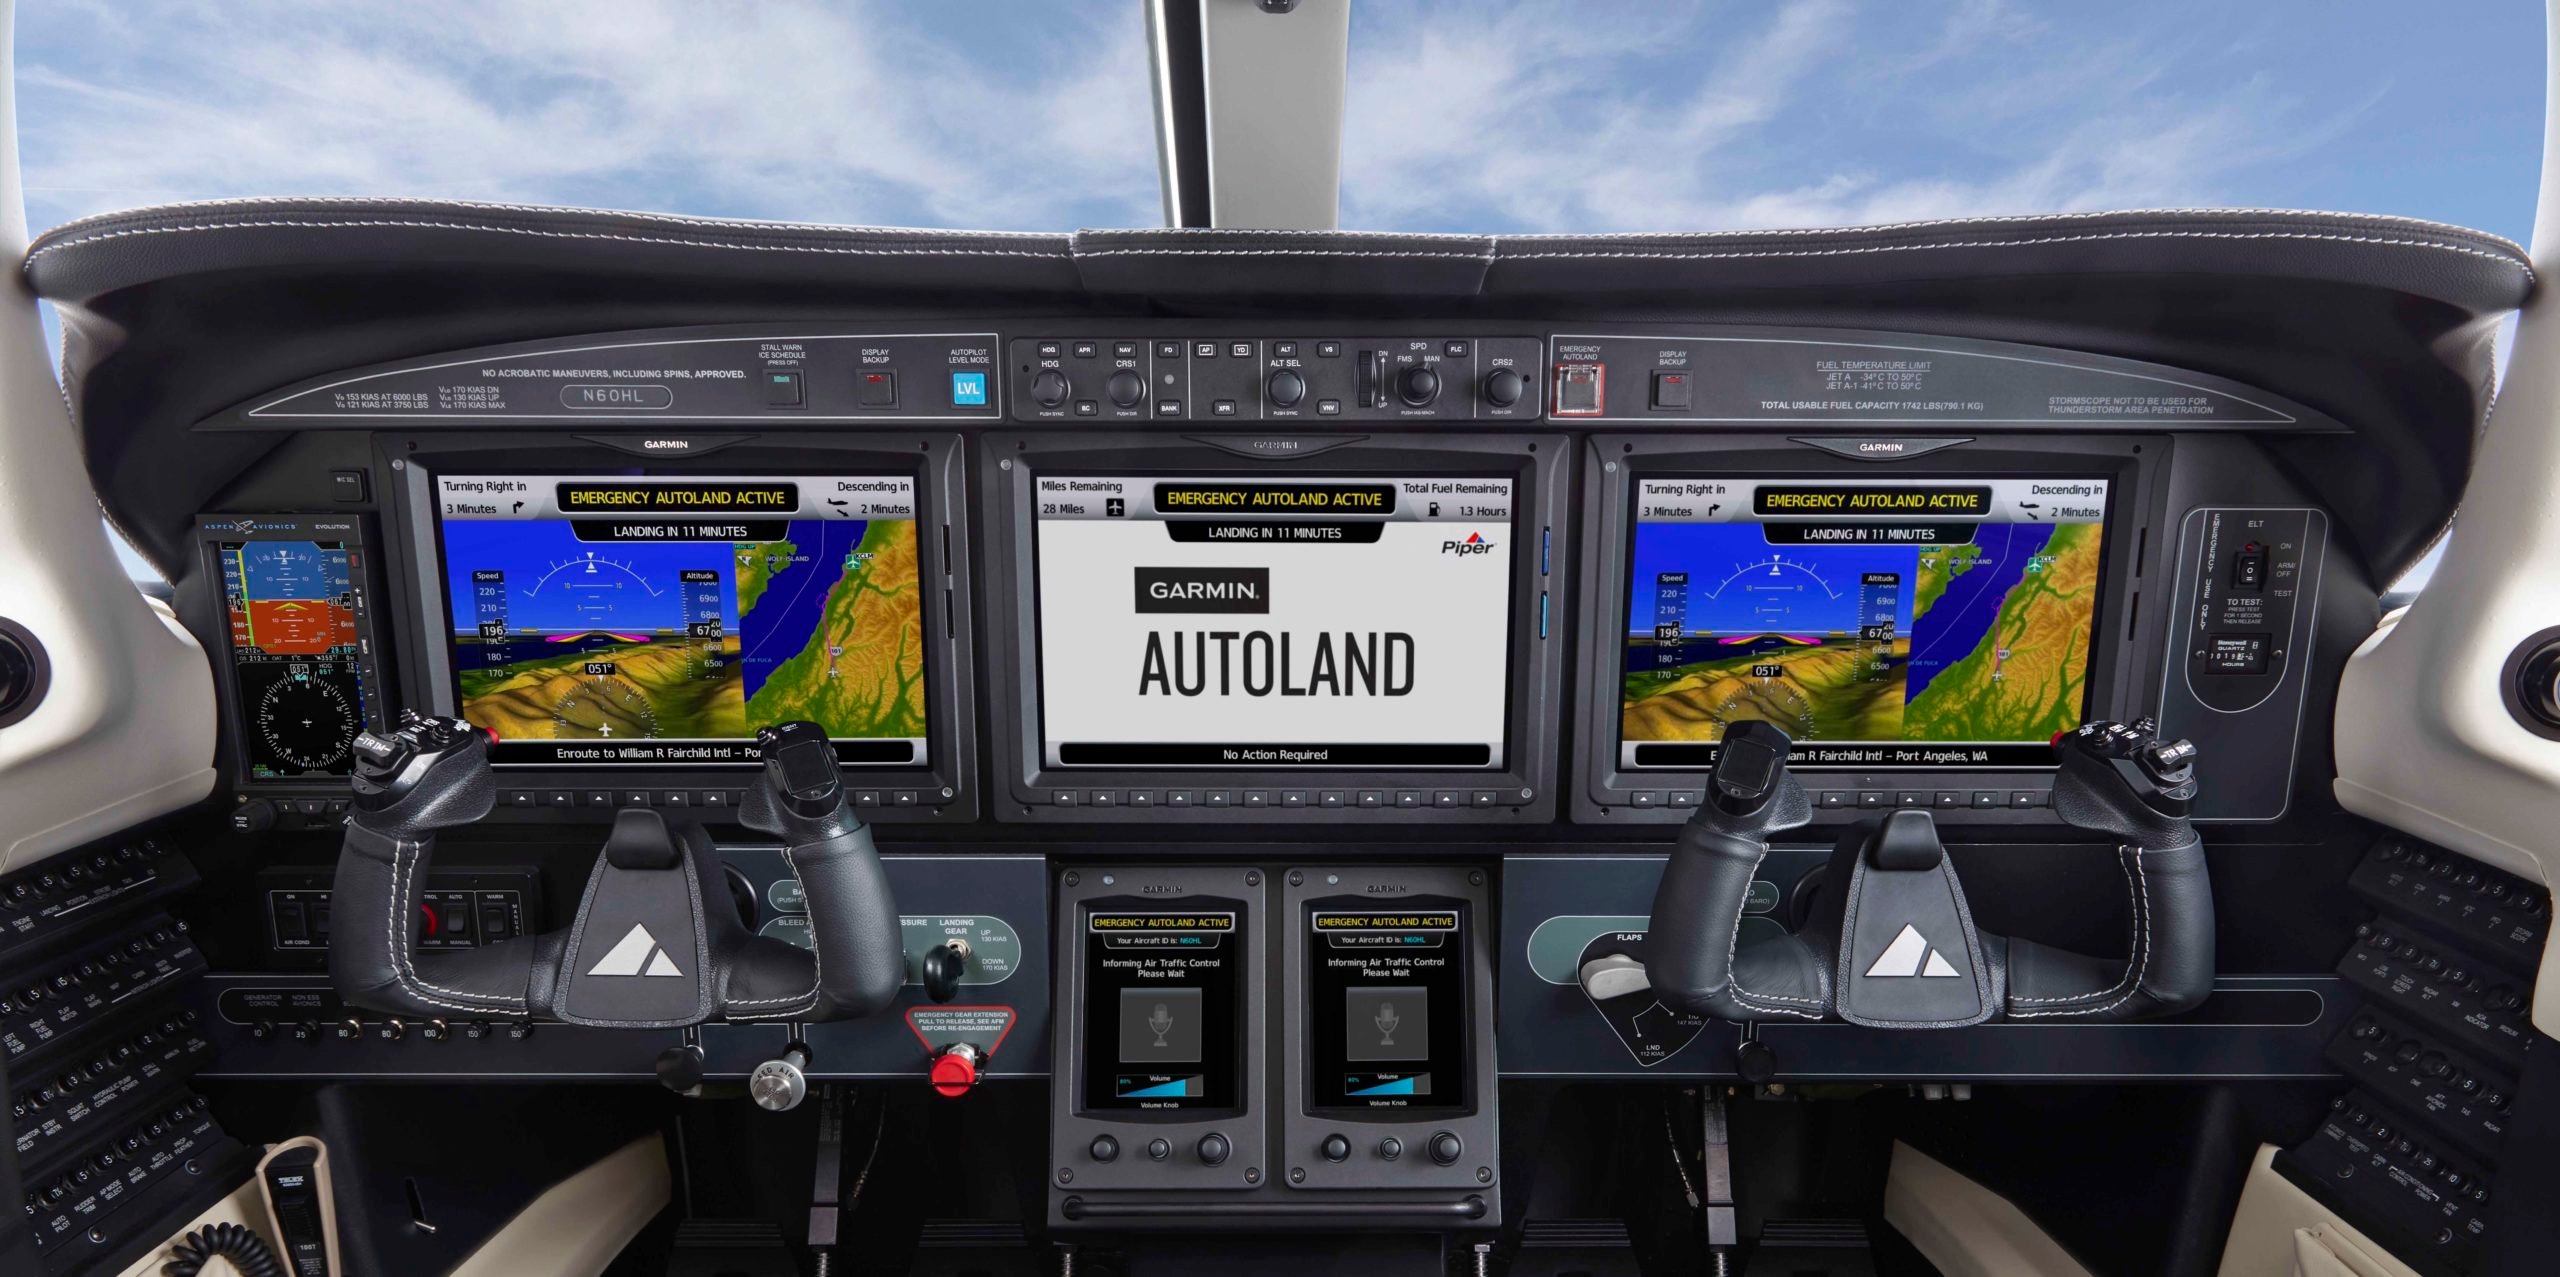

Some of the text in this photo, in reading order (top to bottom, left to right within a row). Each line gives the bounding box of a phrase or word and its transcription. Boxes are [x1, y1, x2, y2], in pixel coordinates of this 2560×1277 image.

[1817, 361, 1931, 370] FUEL TEMPERATURE LIMIT
[498, 369, 550, 377] ACROBATIC
[552, 369, 611, 378] MANEUVERS,
[613, 370, 662, 378] INCLUDING
[664, 370, 693, 379] SPINS,
[694, 370, 746, 378] APPROVED.
[957, 382, 980, 395] LVL
[1761, 401, 1790, 409] TOTAL
[1792, 401, 1828, 409] USABLE
[1855, 401, 1900, 409] CAPACITY
[1923, 402, 1964, 410] LBS(790.1
[1968, 402, 1983, 411] KG)
[2049, 396, 2111, 406] STORMSCOPE
[2048, 405, 2123, 414] THUNDERSTORM
[444, 481, 526, 493] Turning Right in
[838, 481, 909, 494] Descending in
[1042, 481, 1122, 494] Miles Remaining
[1403, 483, 1508, 496] Total Fuel Remaining
[1645, 484, 1725, 496] Turning Right in
[2032, 485, 2103, 497] Descending in
[571, 491, 784, 504] EMERGENCY AUTOLAND ACTIVE
[1168, 492, 1382, 506] EMERGENCY AUTOLAND ACTIVE
[1767, 494, 1978, 507] EMERGENCY AUTOLAND ACTIVE
[447, 504, 497, 514] 3 Minutes
[861, 504, 910, 514] 2 Minutes
[1043, 504, 1085, 514] 28 Miles
[1460, 506, 1506, 517] 1.3 Hours
[614, 526, 747, 537] LANDING IN 11 MINUTES
[1209, 527, 1342, 538] LANDING IN 11 MINUTES
[1804, 529, 1935, 540] LANDING IN 11 MINUTES
[1442, 541, 1492, 556] Piper
[477, 572, 499, 580] Speed
[484, 626, 503, 636] 196
[1139, 630, 1414, 697] AUTOLAND
[557, 748, 731, 758] Enroute to William R Fairchild Intl
[1224, 750, 1328, 762] No Action Required
[1809, 751, 1816, 760] R
[1820, 750, 1863, 761] Fairchild
[1866, 750, 1882, 760] Intl
[1896, 751, 1919, 761] Port
[1923, 751, 1968, 763] Angeles,
[1972, 751, 1988, 761] WA
[1143, 885, 1182, 894] GARMIN
[1093, 919, 1145, 928] EMERGENCY
[1103, 959, 1142, 969] Informing
[1160, 959, 1186, 967] Traffic
[1189, 959, 1220, 967] Control
[1138, 968, 1165, 977] Please
